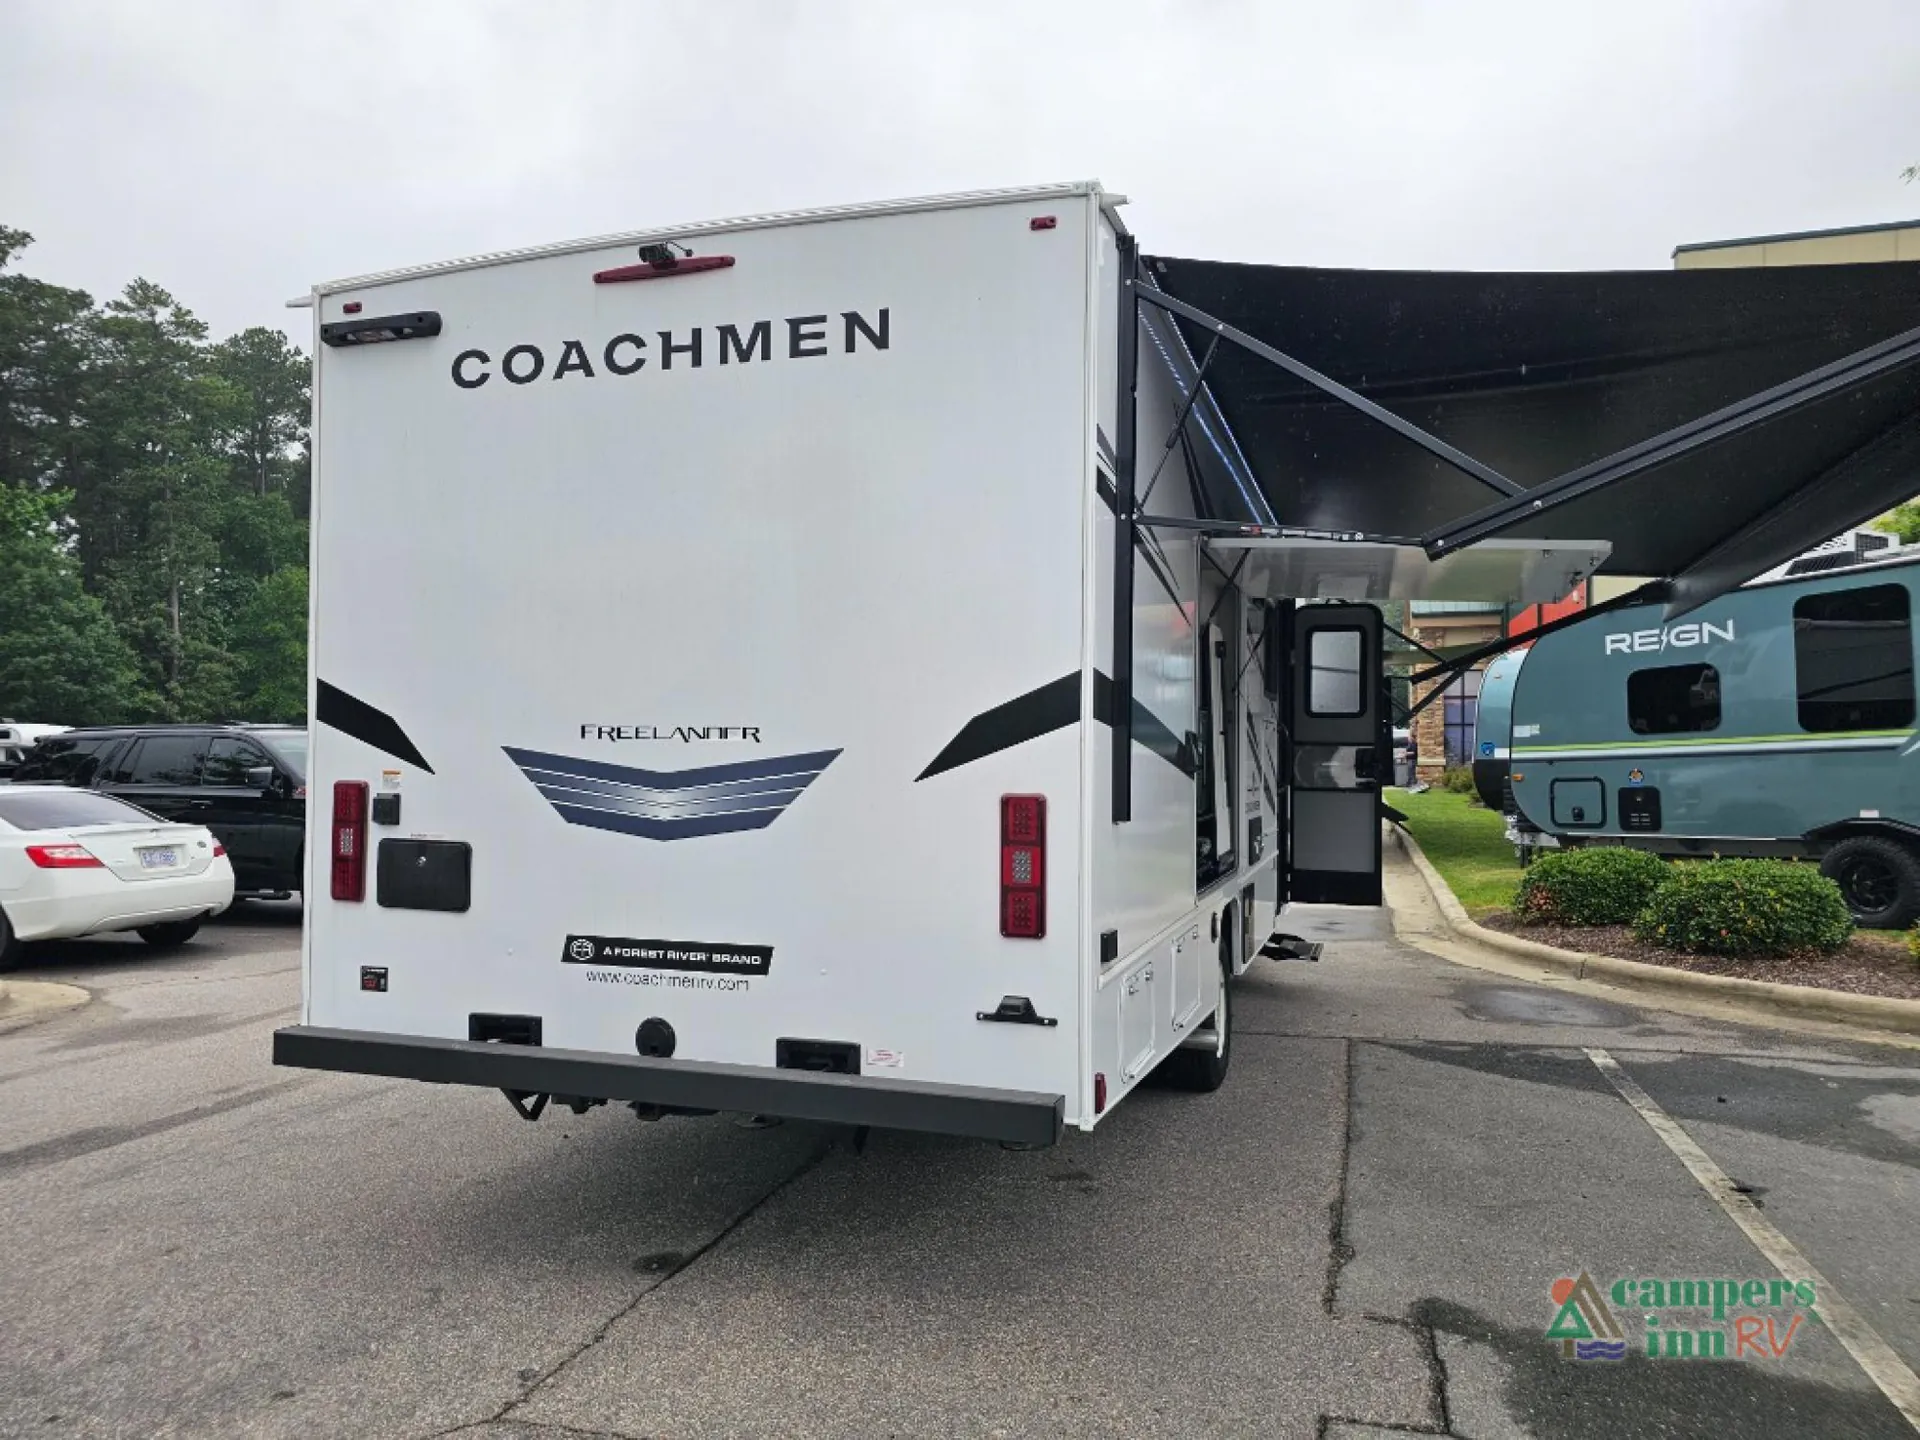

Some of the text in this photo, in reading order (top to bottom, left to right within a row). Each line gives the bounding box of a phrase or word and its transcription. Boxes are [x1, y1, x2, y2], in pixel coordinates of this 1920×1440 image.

[451, 308, 890, 389] COACHMEN
[1604, 618, 1735, 655] REIGN
[580, 724, 761, 743] FREELANDER
[603, 946, 762, 965] A FOREST RIVER BRAND
[586, 970, 749, 992] www.coachmenrv.com
